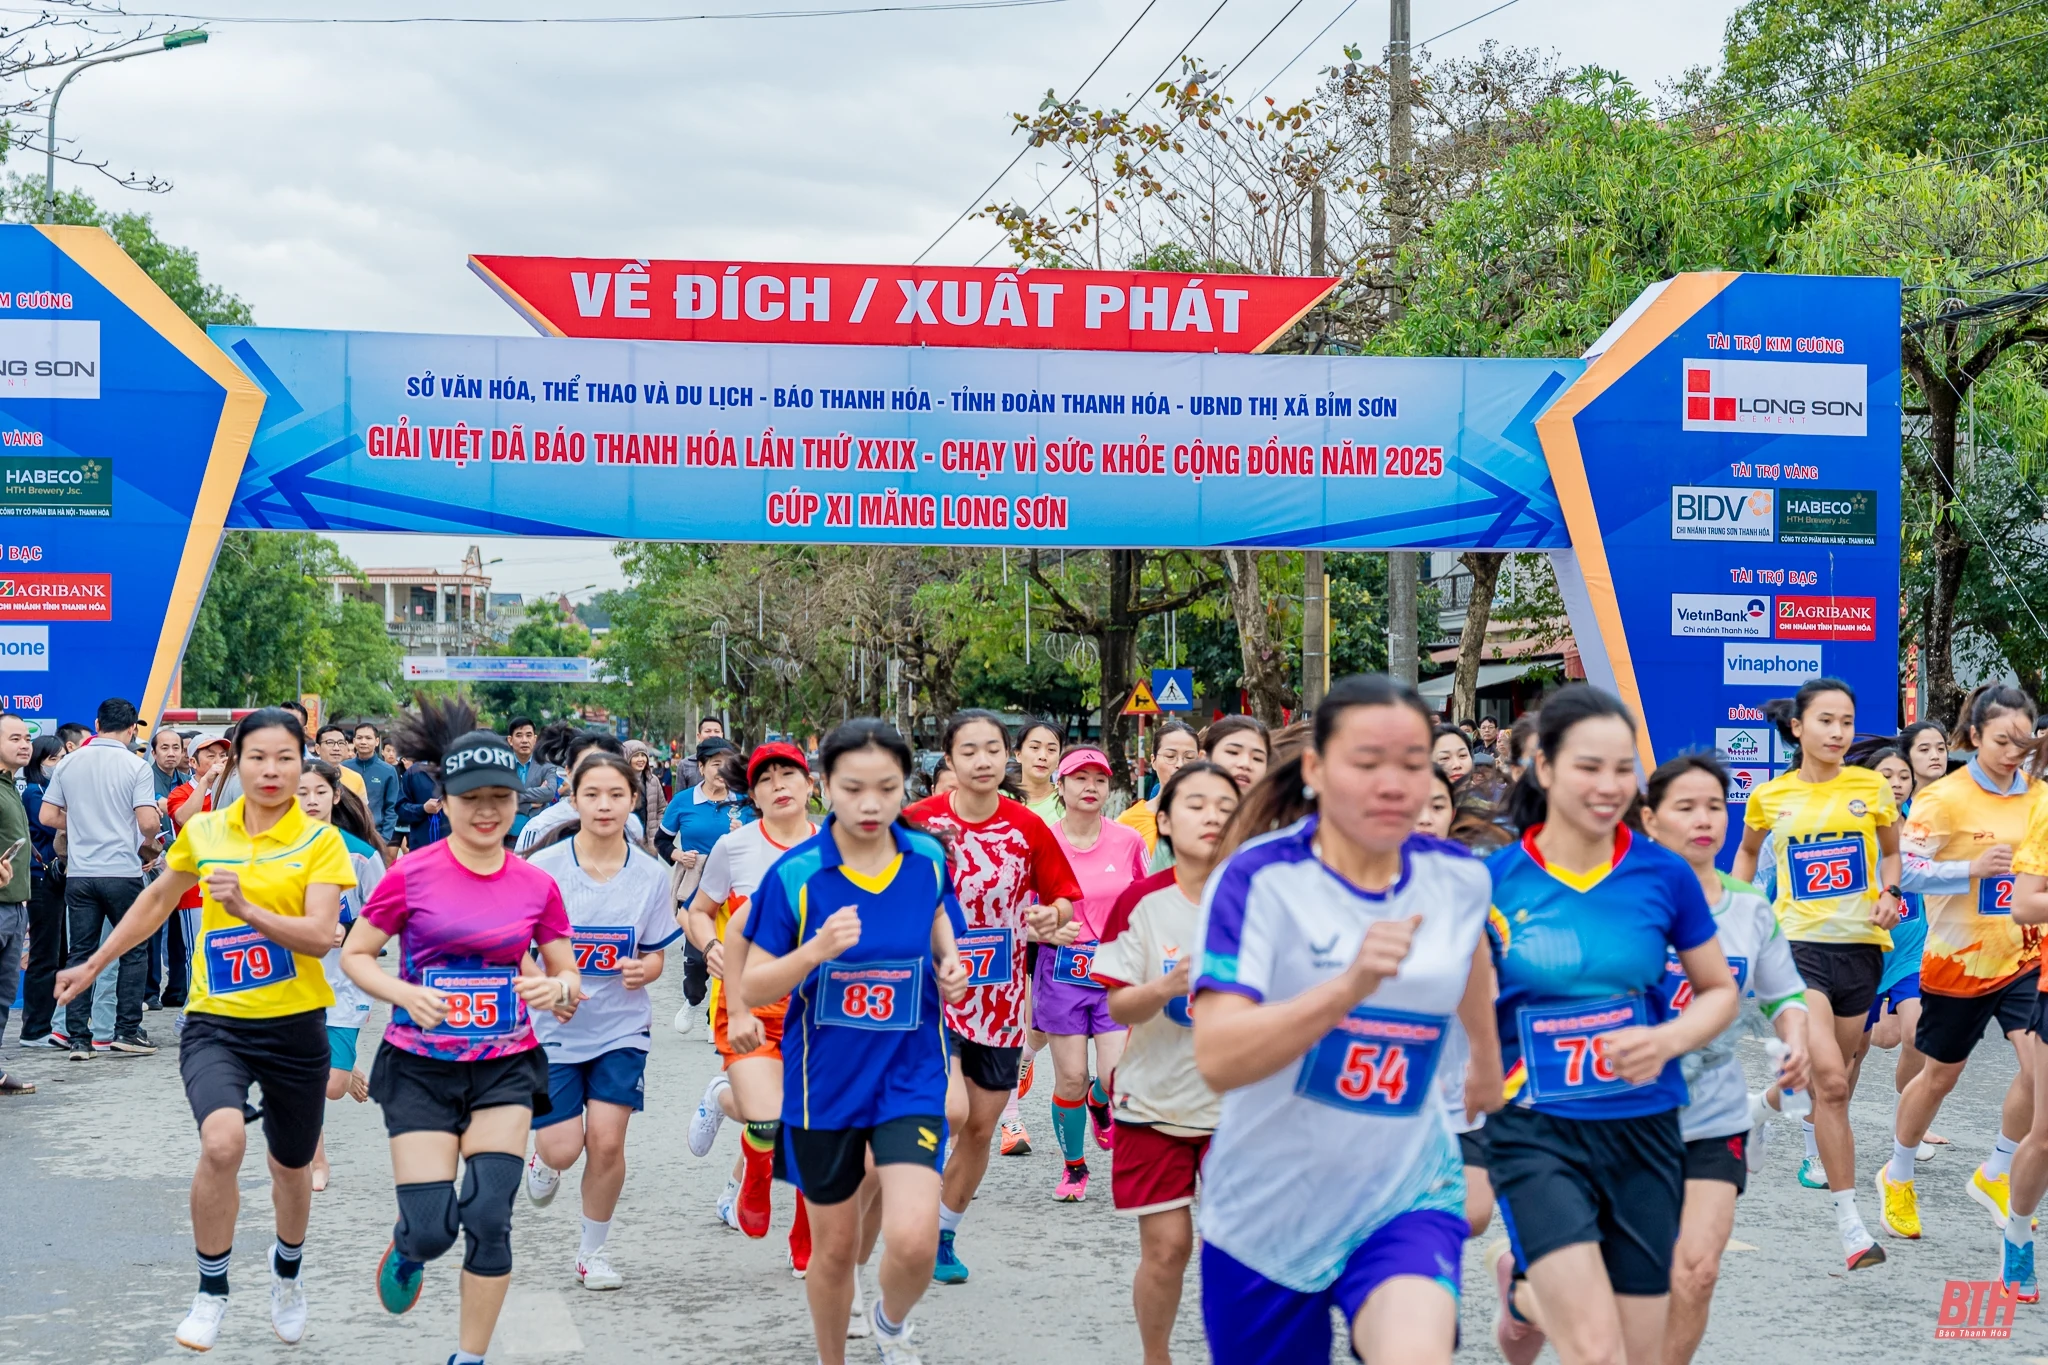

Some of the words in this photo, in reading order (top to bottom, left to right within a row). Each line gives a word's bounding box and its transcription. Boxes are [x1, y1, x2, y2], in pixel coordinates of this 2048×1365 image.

[17, 291, 72, 309] CƯƠNG
[570, 258, 650, 318] VỀ
[673, 266, 830, 322] ĐÍCH
[848, 278, 878, 323] /
[895, 267, 1064, 327] XUẤT
[1085, 279, 1249, 333] PHÁT
[1708, 332, 1730, 349] TÀI
[1734, 334, 1761, 353] TRỢ
[1766, 337, 1791, 351] KIM
[1797, 337, 1843, 354] CƯƠNG
[35, 361, 94, 377] SON
[407, 370, 435, 396] SỞ
[442, 374, 482, 398] VĂN
[489, 376, 536, 403] HÓA,
[542, 374, 580, 402] THỂ
[586, 382, 636, 404] THAO
[644, 380, 669, 404] VÀ
[676, 386, 702, 405] DU
[710, 386, 752, 410] LỊCH
[774, 384, 813, 408] BÁO
[820, 389, 885, 410] THANH
[892, 387, 931, 410] HÓA
[951, 386, 995, 411] TỈNH
[1002, 390, 1055, 413] ĐOÀN
[1062, 394, 1125, 414] THANH
[1132, 392, 1170, 415] HÓA
[1190, 396, 1242, 416] UBND
[1249, 397, 1277, 420] THỊ
[1284, 394, 1309, 416] XÃ
[1316, 392, 1352, 417] BỈM
[1358, 396, 1396, 417] SƠN
[1740, 398, 1805, 414] LONG
[1812, 401, 1862, 416] SON
[1740, 416, 1806, 424] CEMENT
[2, 429, 42, 446] VÀNG
[368, 416, 420, 458] GIẢI
[429, 423, 483, 466] VIỆT
[492, 425, 525, 460] DÃ
[535, 426, 584, 462] BÁO
[594, 434, 677, 465] THANH
[687, 430, 737, 466] HÓA
[746, 427, 793, 467] LẦN
[803, 433, 852, 468] THỨ
[858, 440, 916, 470] XXIX
[942, 441, 1006, 478] CHẠY
[1014, 437, 1036, 472] VÌ
[1046, 437, 1093, 472] SỨC
[1102, 435, 1165, 473] KHỎE
[1174, 439, 1239, 480] CỘNG
[1248, 436, 1313, 475] ĐỒNG
[1322, 440, 1376, 475] NĂM
[1386, 447, 1442, 476] 2025
[6, 470, 83, 484] HABECO
[1731, 462, 1751, 477] TÀI
[1756, 464, 1780, 480] TRỢ
[1784, 464, 1818, 479] VÀNG
[6, 486, 26, 494] HTH
[28, 486, 64, 496] Brewery
[67, 487, 83, 495] Jsc.
[768, 488, 817, 524] CÚP
[826, 495, 850, 525] XI
[860, 490, 934, 527] MĂNG
[943, 497, 1007, 527] LONG
[1016, 496, 1066, 528] SƠN
[1678, 495, 1748, 521] BIDV
[1787, 500, 1852, 514] HABECO
[1806, 516, 1836, 525] Brewery
[9, 546, 42, 563] BẠC
[1730, 567, 1752, 583] TÀI
[1757, 569, 1784, 586] TRỢ
[1789, 571, 1817, 587] BẠC
[16, 585, 106, 597] AGRIBANK
[13, 602, 40, 610] NHÁNH
[89, 602, 106, 611] HÓA
[1677, 608, 1748, 622] VietinBank
[1795, 606, 1871, 618] AGRIBANK
[1727, 654, 1818, 673] vinaphone
[13, 694, 42, 711] TRỢ
[1728, 704, 1764, 720] ĐỒNG
[445, 746, 515, 775] SPORT
[1806, 859, 1852, 892] 25
[1996, 880, 2013, 908] 2
[222, 945, 272, 984] 79
[573, 943, 618, 970] 73
[959, 948, 995, 978] 57
[446, 992, 498, 1028] 85
[842, 983, 895, 1021] 83
[1554, 1035, 1619, 1086] 78
[1336, 1042, 1408, 1105] 54
